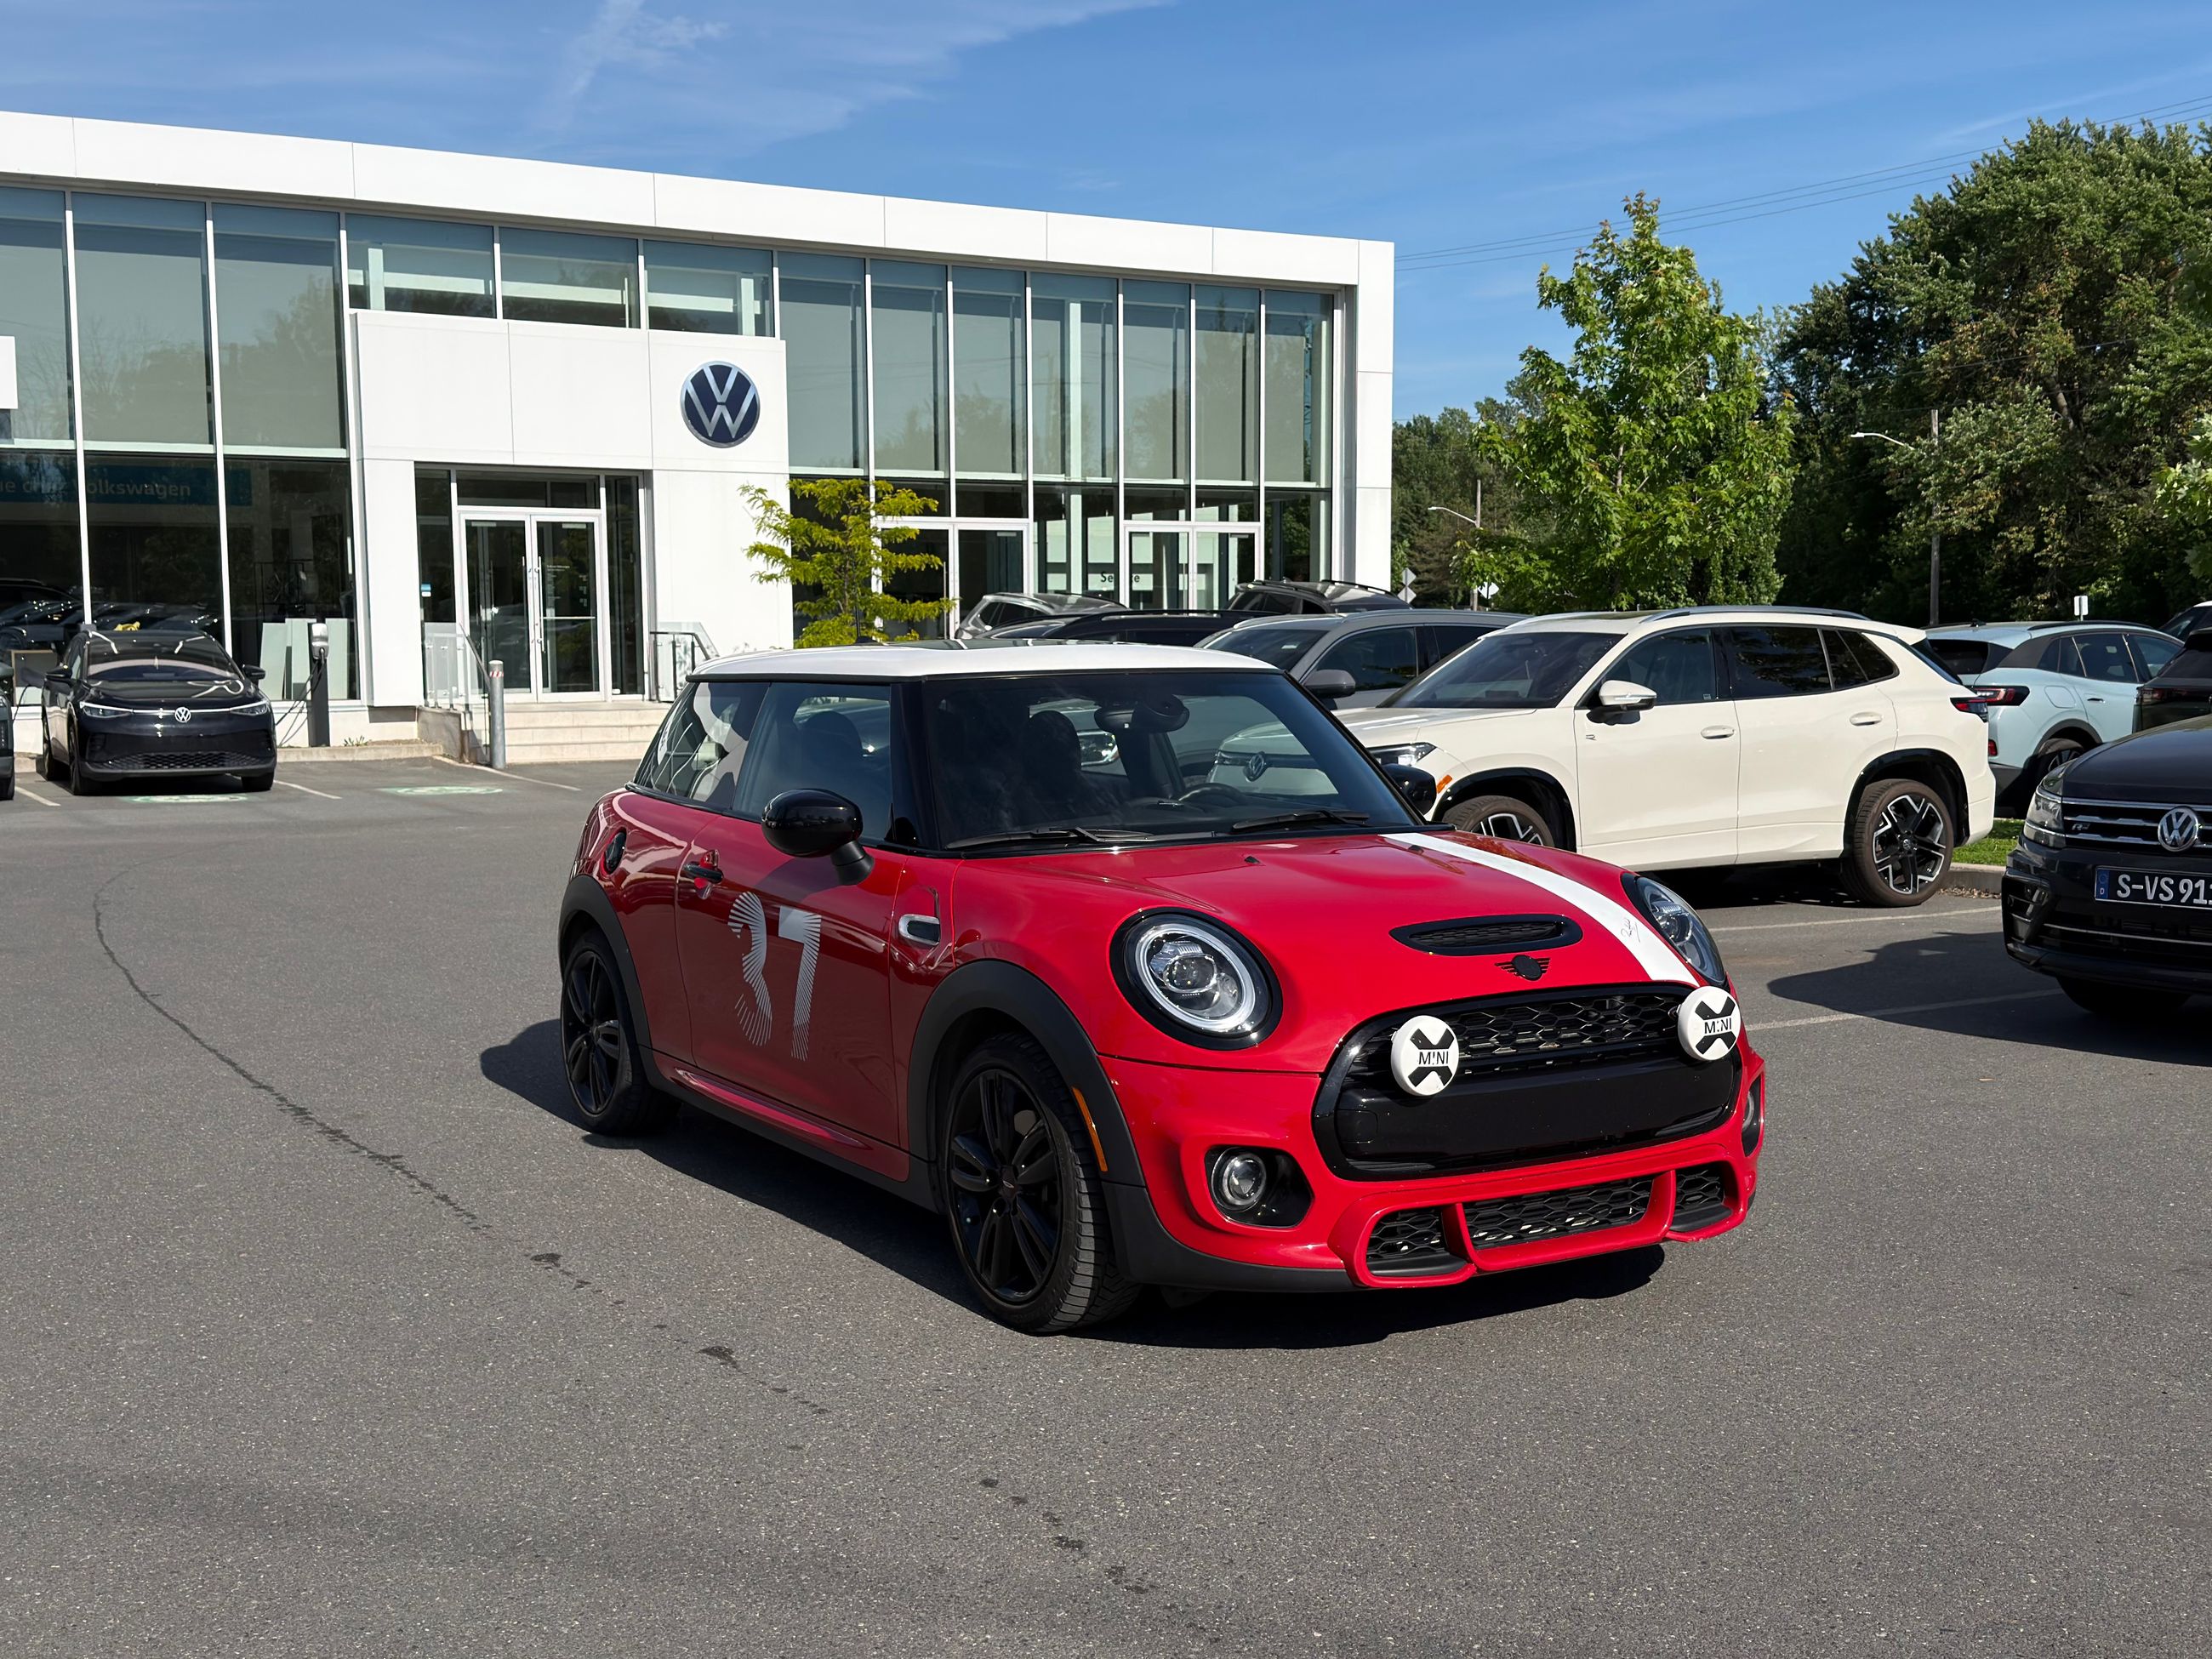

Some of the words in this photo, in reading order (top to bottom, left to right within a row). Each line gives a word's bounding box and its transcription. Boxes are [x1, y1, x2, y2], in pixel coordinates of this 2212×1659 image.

[681, 362, 760, 448] VW
[175, 707, 191, 723] VW
[2158, 807, 2198, 852] VW
[2117, 874, 2174, 902] S-VS
[727, 892, 822, 1062] 37
